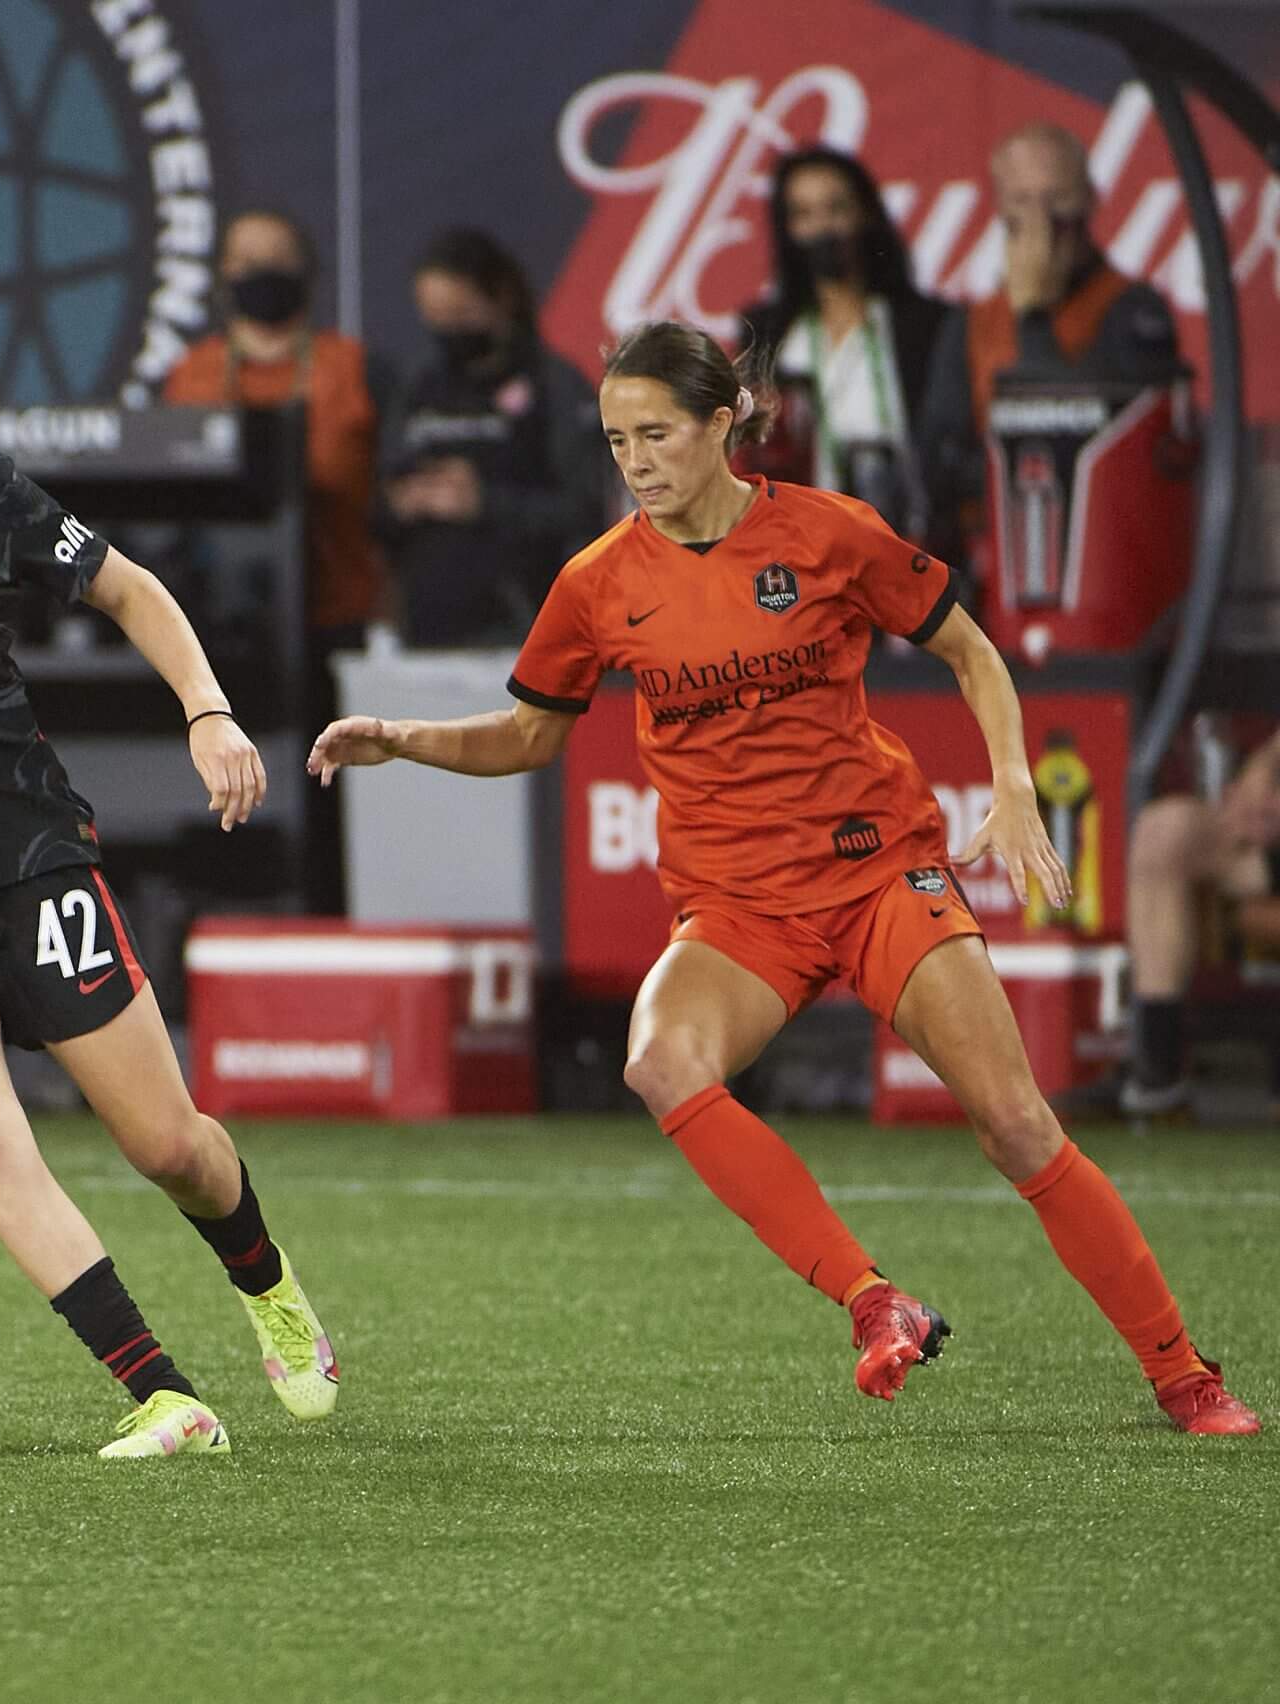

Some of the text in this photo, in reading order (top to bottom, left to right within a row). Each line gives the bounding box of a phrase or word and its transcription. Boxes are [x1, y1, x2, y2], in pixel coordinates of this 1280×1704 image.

[54, 514, 94, 563] ally
[676, 639, 827, 695] Anderson
[837, 828, 879, 852] HOU
[36, 888, 114, 979] 42
